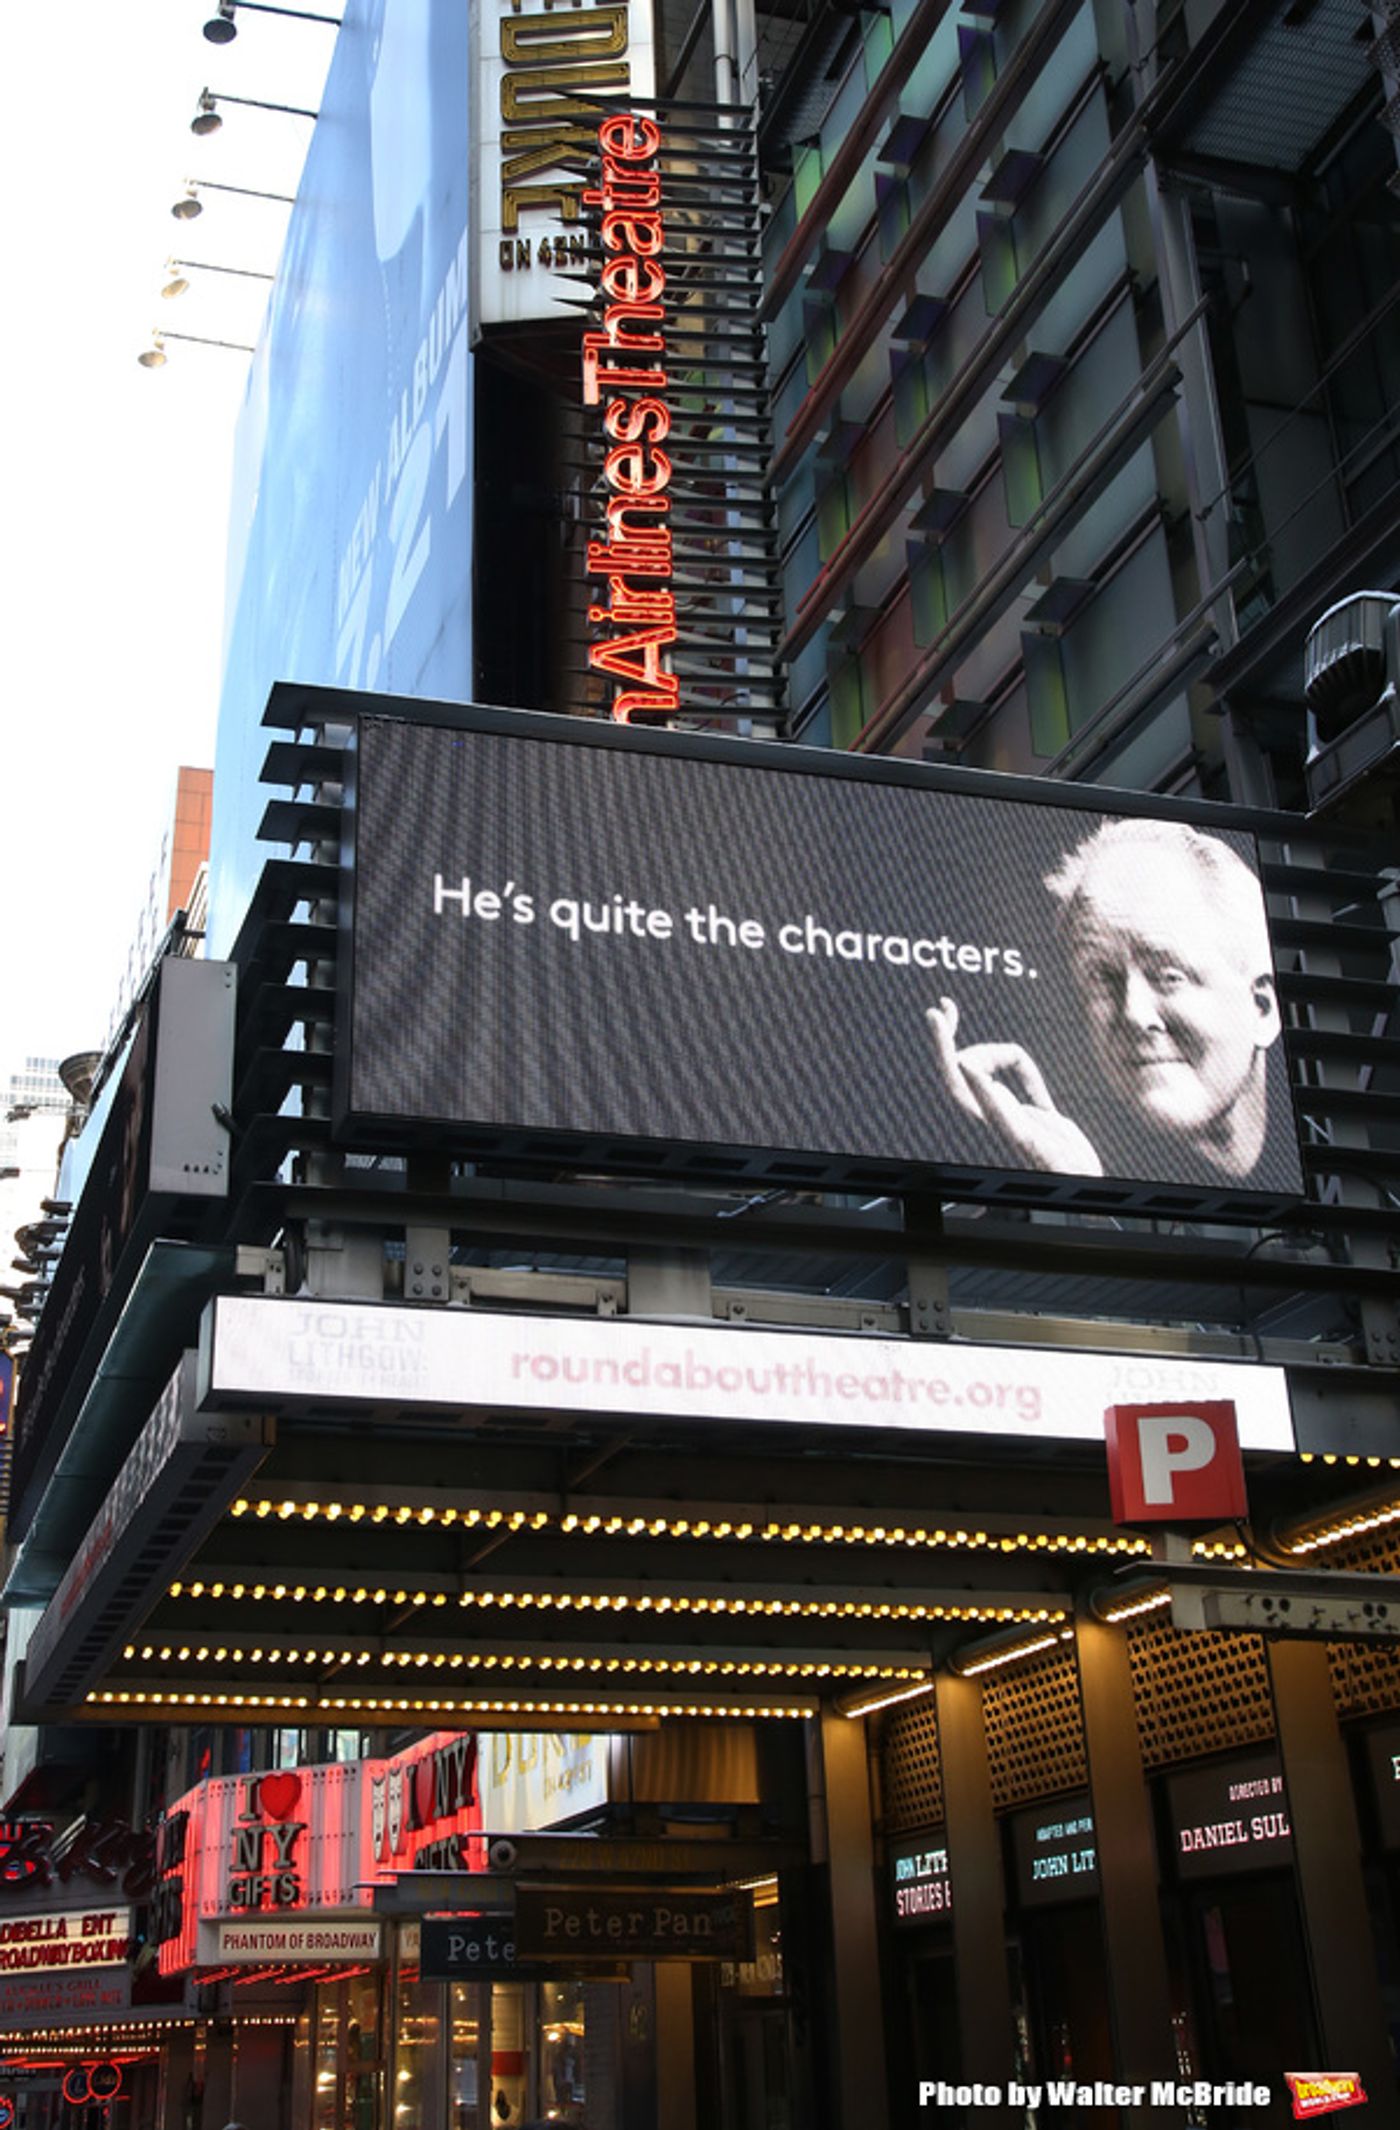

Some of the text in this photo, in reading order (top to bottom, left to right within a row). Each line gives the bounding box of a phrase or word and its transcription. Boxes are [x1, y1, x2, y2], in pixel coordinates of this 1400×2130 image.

[500, 5, 629, 235] DUKE
[500, 232, 587, 271] ON 42N
[337, 225, 468, 630] NEW ALBUM
[432, 873, 1039, 979] He's quite the characters.
[289, 1311, 426, 1342] JOHN
[511, 1347, 1042, 1421] roundabouttheatre.org
[1137, 1416, 1216, 1505] P
[432, 1736, 475, 1819] NY
[239, 1777, 262, 1822] I
[230, 1823, 306, 1872] NY
[1180, 1819, 1249, 1852] DANIEL
[1033, 1853, 1068, 1881] JOHN
[230, 1873, 300, 1907] GIFTS
[895, 1882, 944, 1917] STORIES
[0, 1915, 67, 1943] DIBELLA
[82, 1911, 117, 1938] ENT
[223, 1931, 377, 1951] PHANTOM OF BROADWAY
[543, 1906, 714, 1937] Peter Pan
